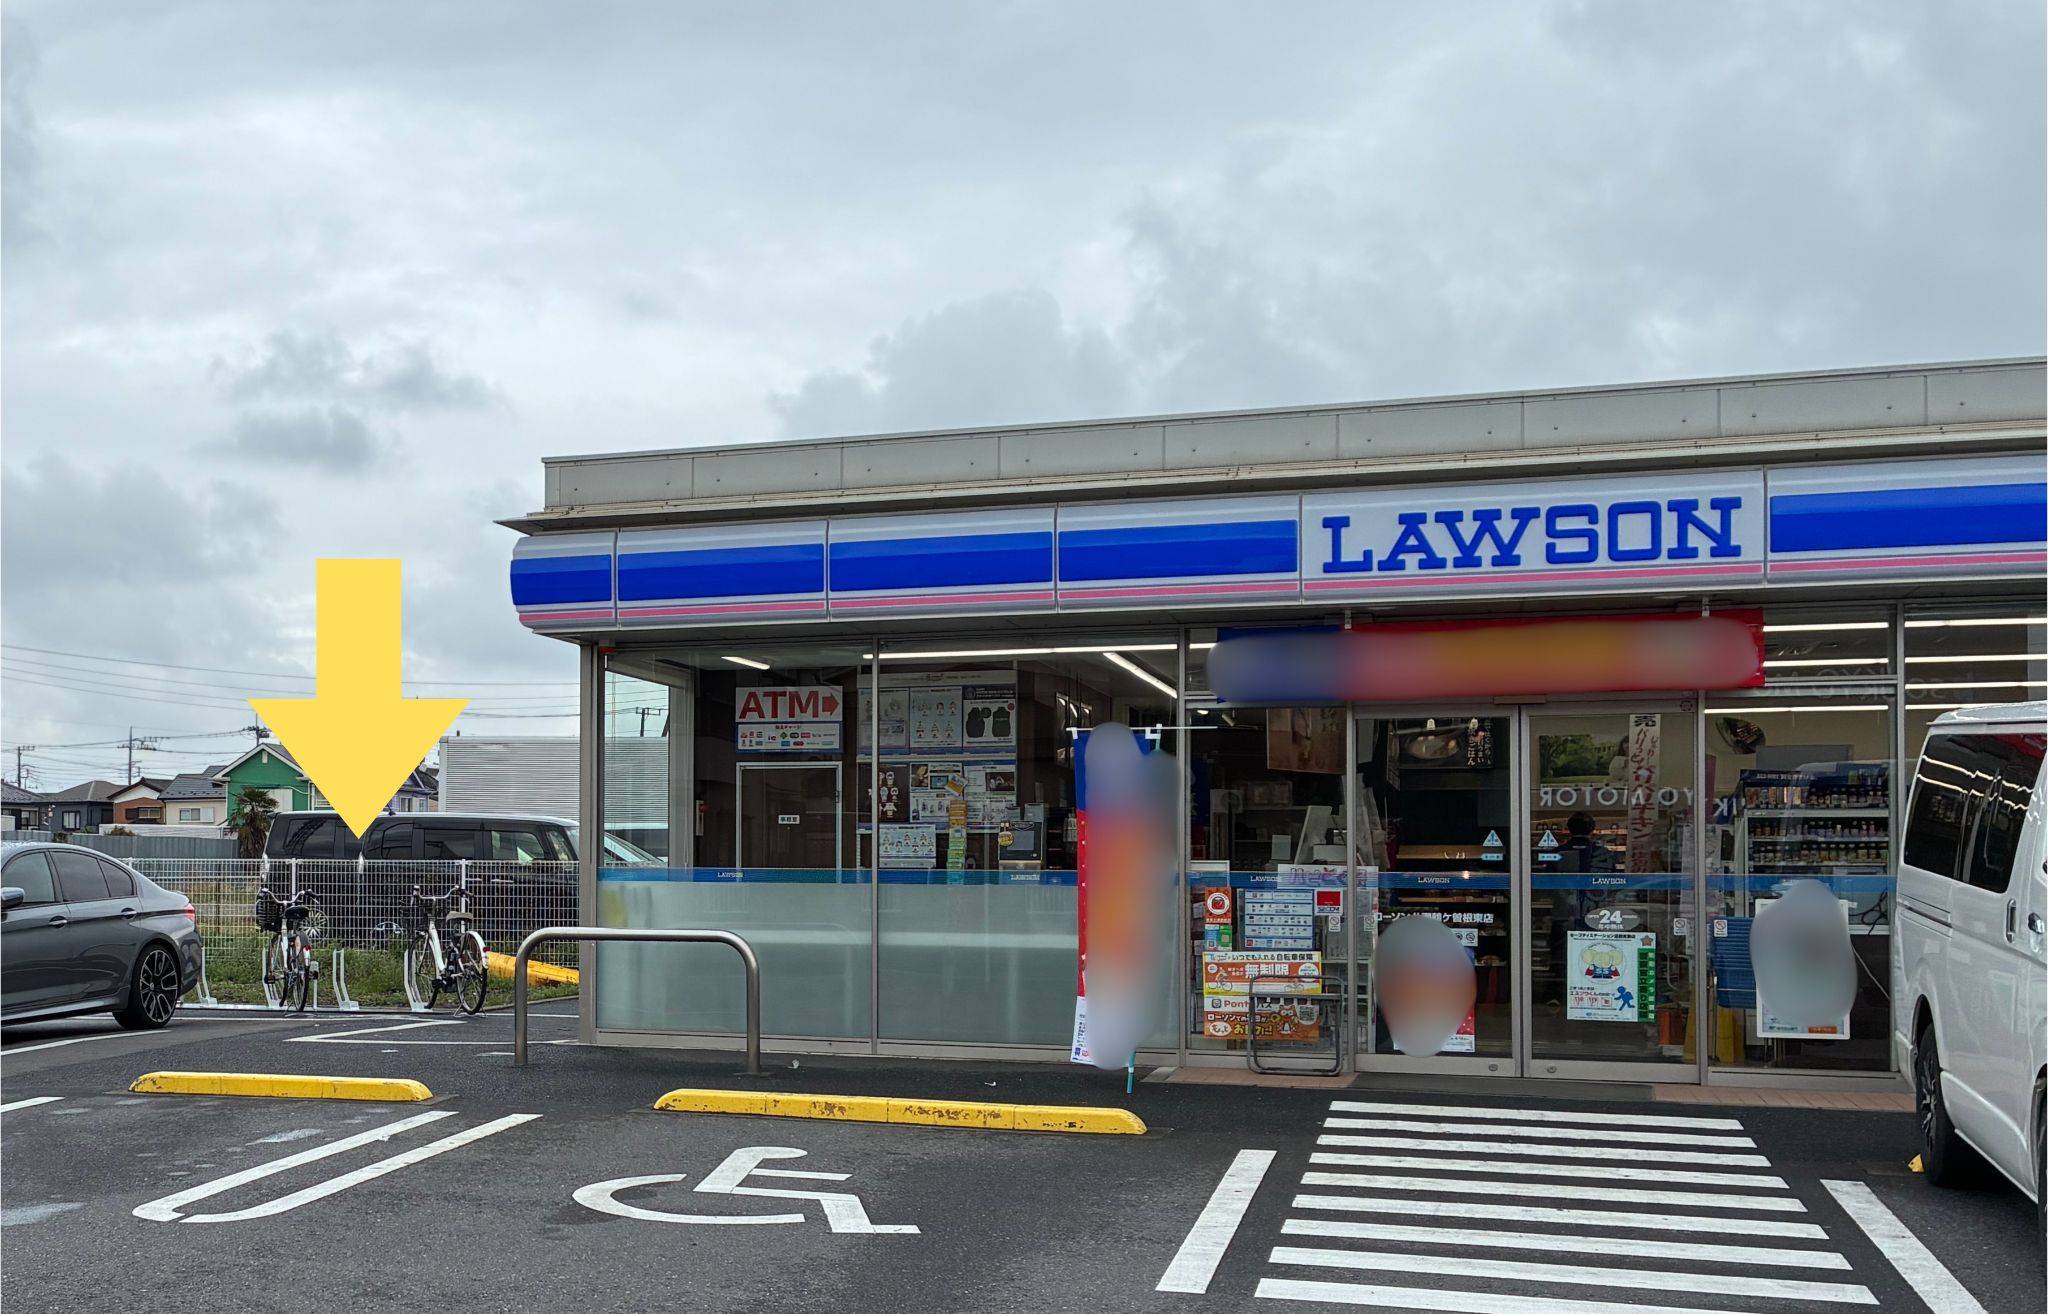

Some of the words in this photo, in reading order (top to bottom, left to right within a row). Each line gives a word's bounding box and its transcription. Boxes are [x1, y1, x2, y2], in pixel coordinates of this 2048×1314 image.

[1322, 496, 1742, 574] LAWSON
[738, 690, 819, 719] ATM
[1599, 909, 1623, 923] 24
[1245, 962, 1290, 979] 無制限
[1223, 1000, 1273, 1009] Pontパス
